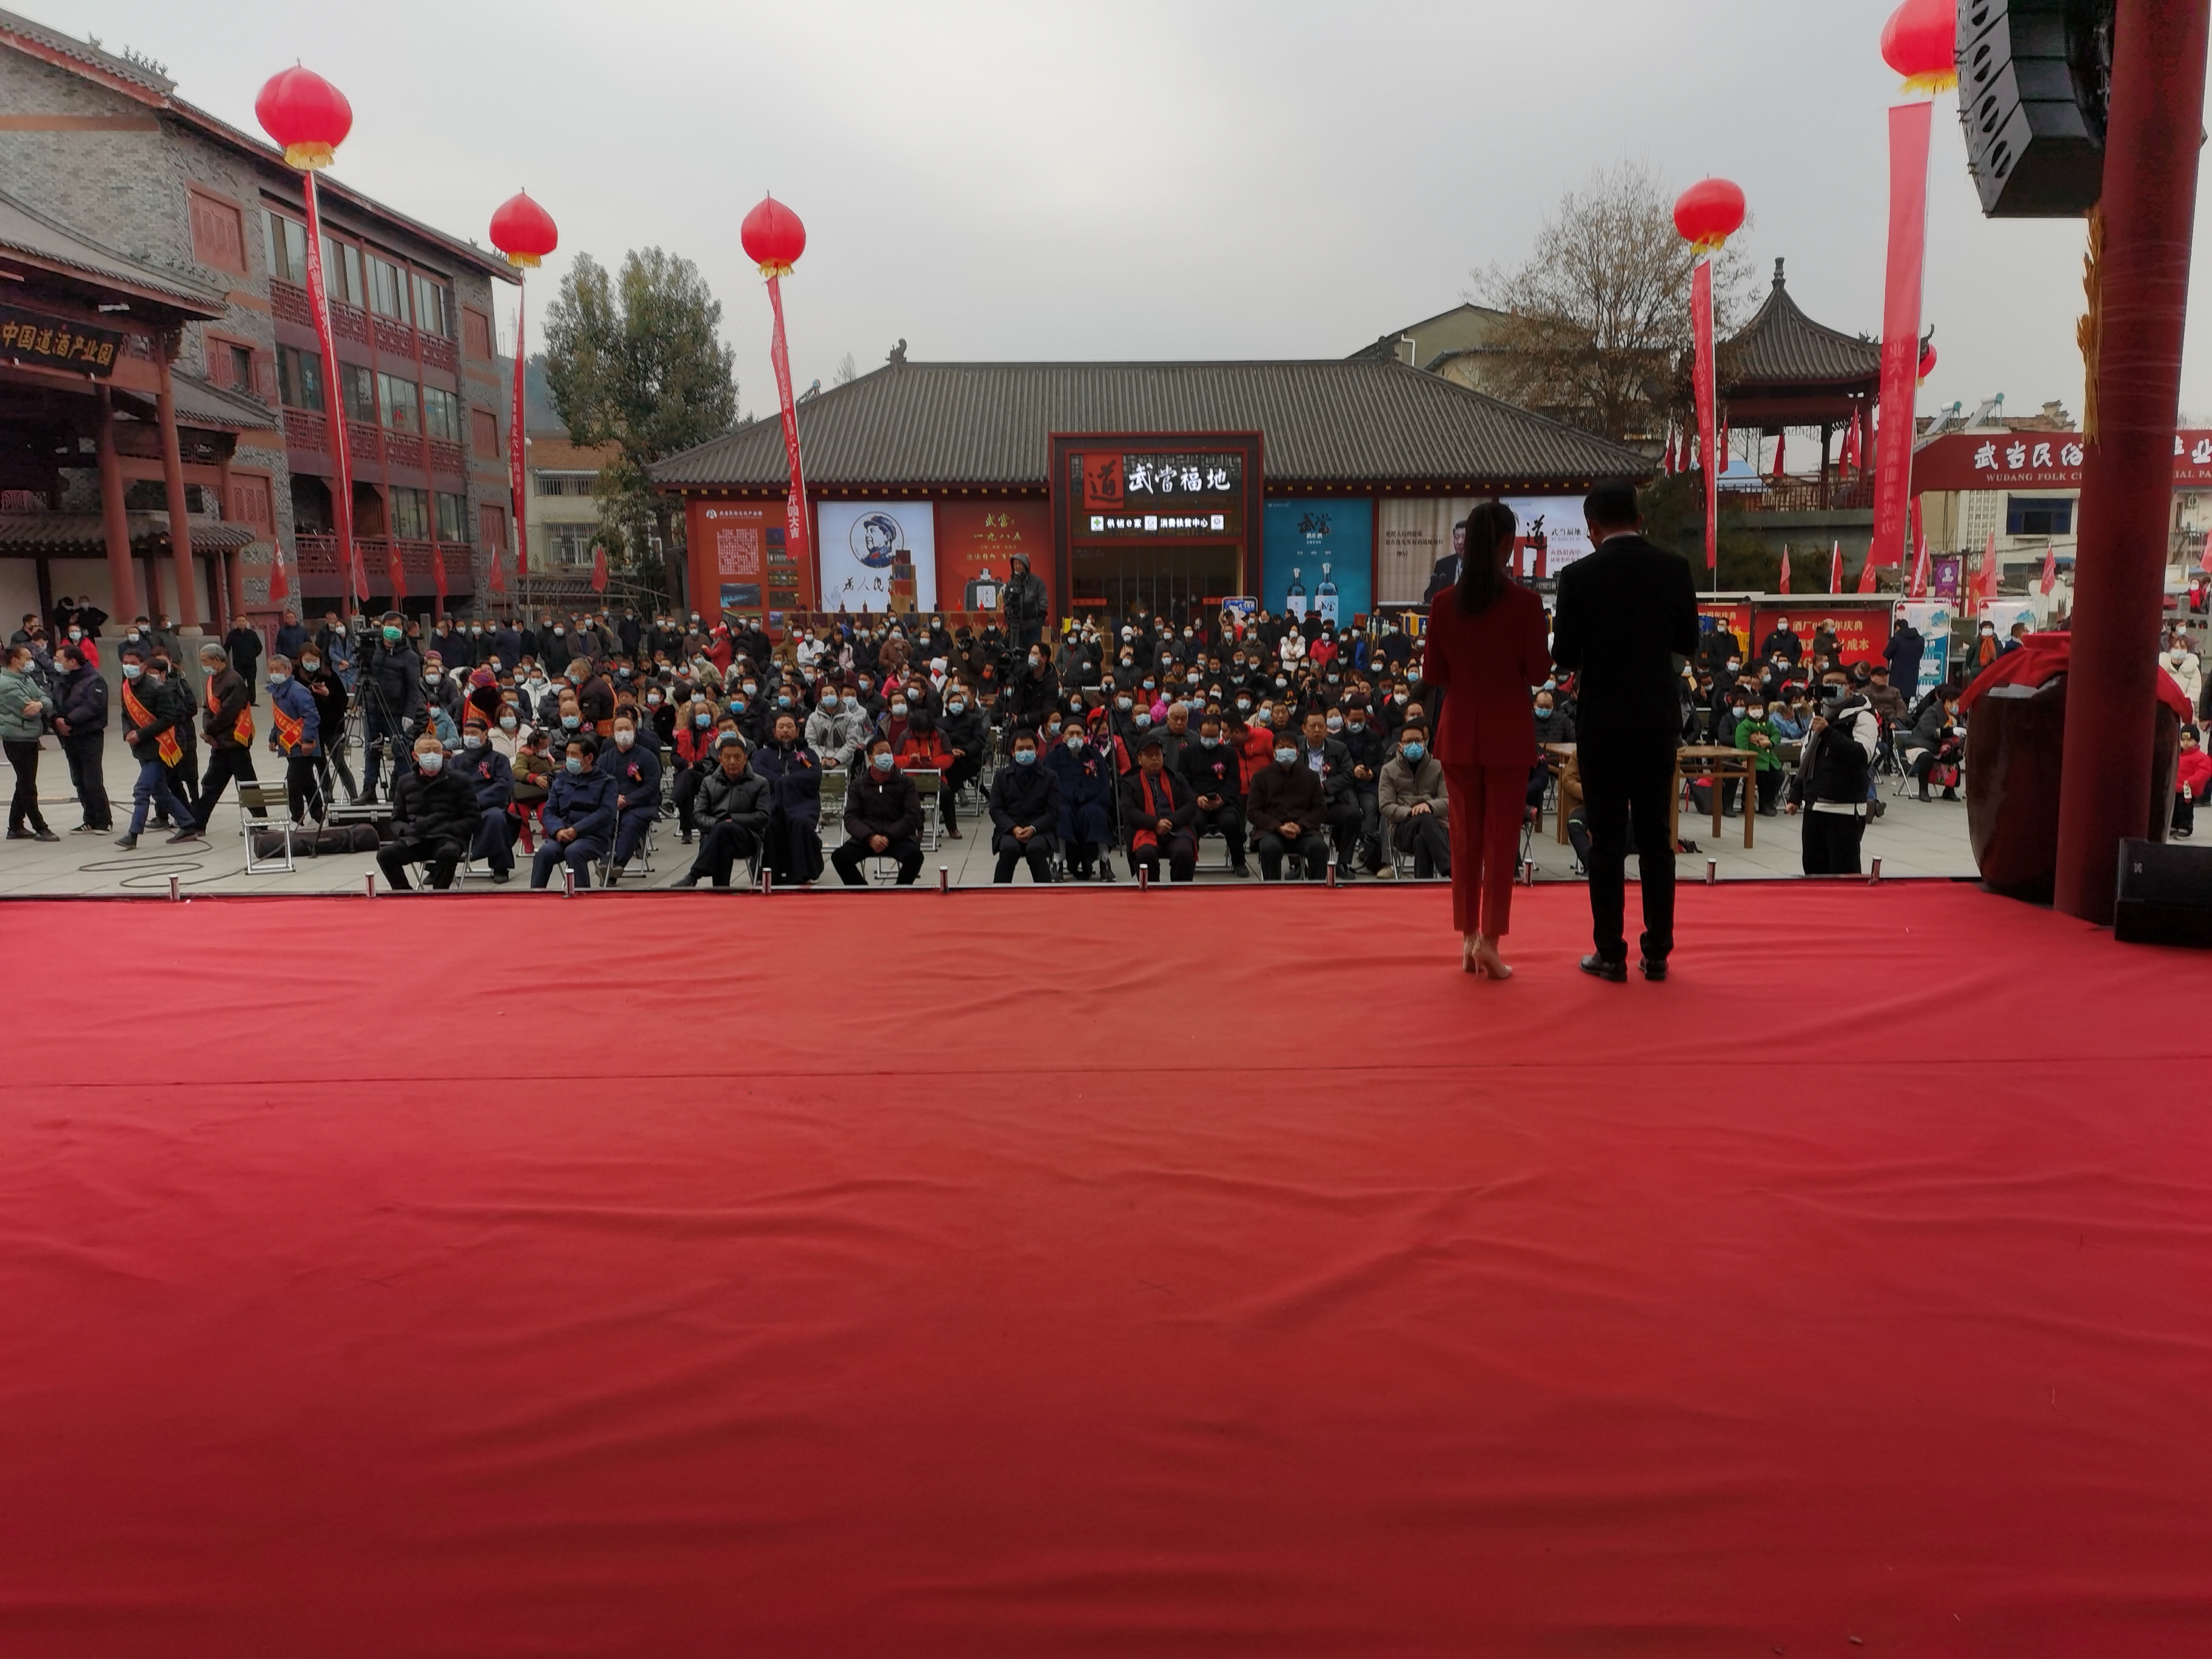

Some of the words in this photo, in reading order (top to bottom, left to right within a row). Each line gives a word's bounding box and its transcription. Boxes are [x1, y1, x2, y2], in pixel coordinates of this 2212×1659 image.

[2, 320, 113, 366] 中国道酒产业园
[1986, 473, 2033, 482] WUDANG
[2038, 472, 2066, 481] FOLK
[843, 576, 893, 592] 为人民
